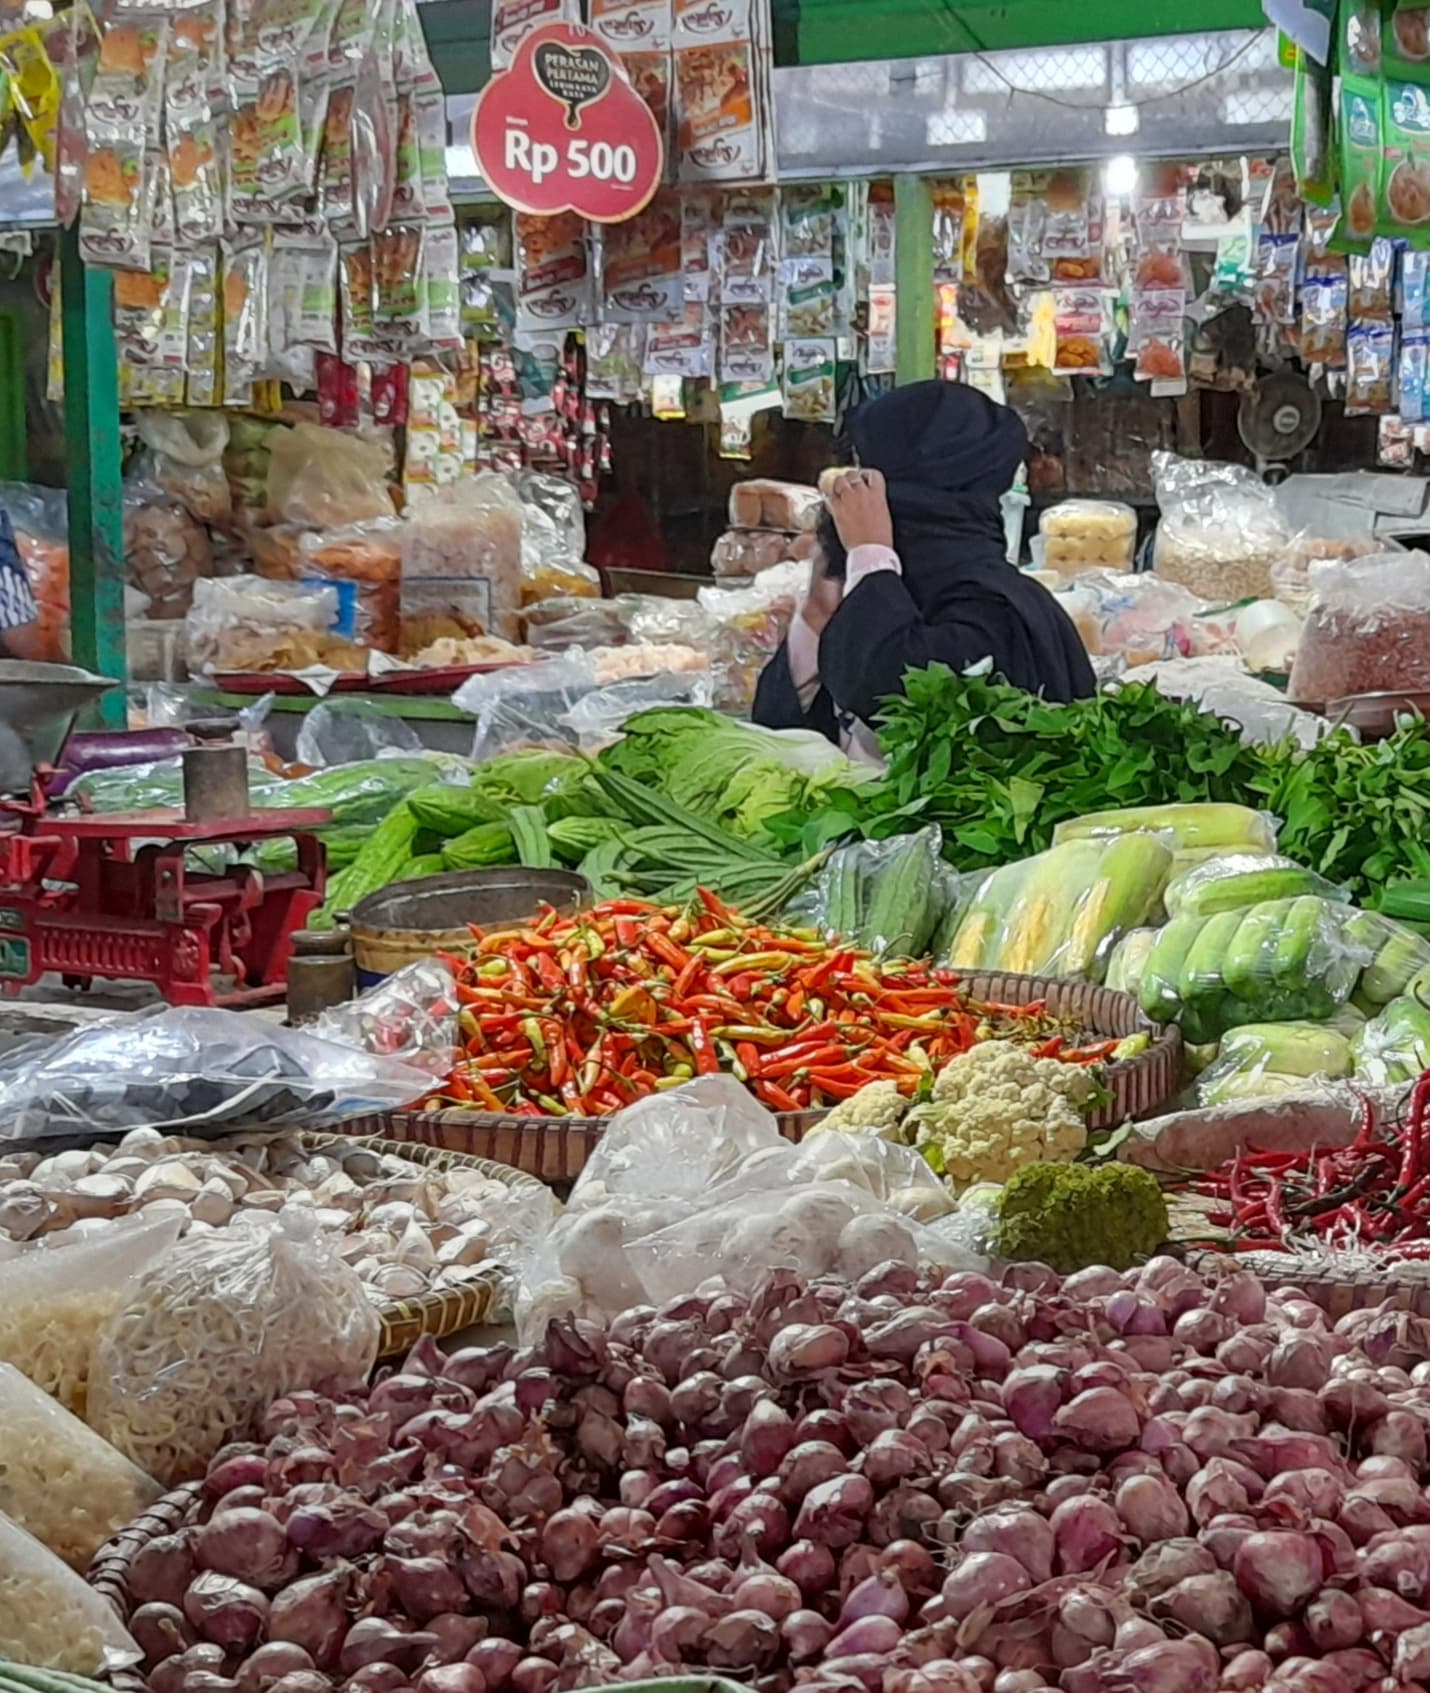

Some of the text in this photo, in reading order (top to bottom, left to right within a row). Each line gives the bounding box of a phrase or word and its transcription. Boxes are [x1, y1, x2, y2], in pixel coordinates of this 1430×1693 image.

[544, 53, 599, 71] PERASAN
[505, 129, 636, 184] Rp 500
